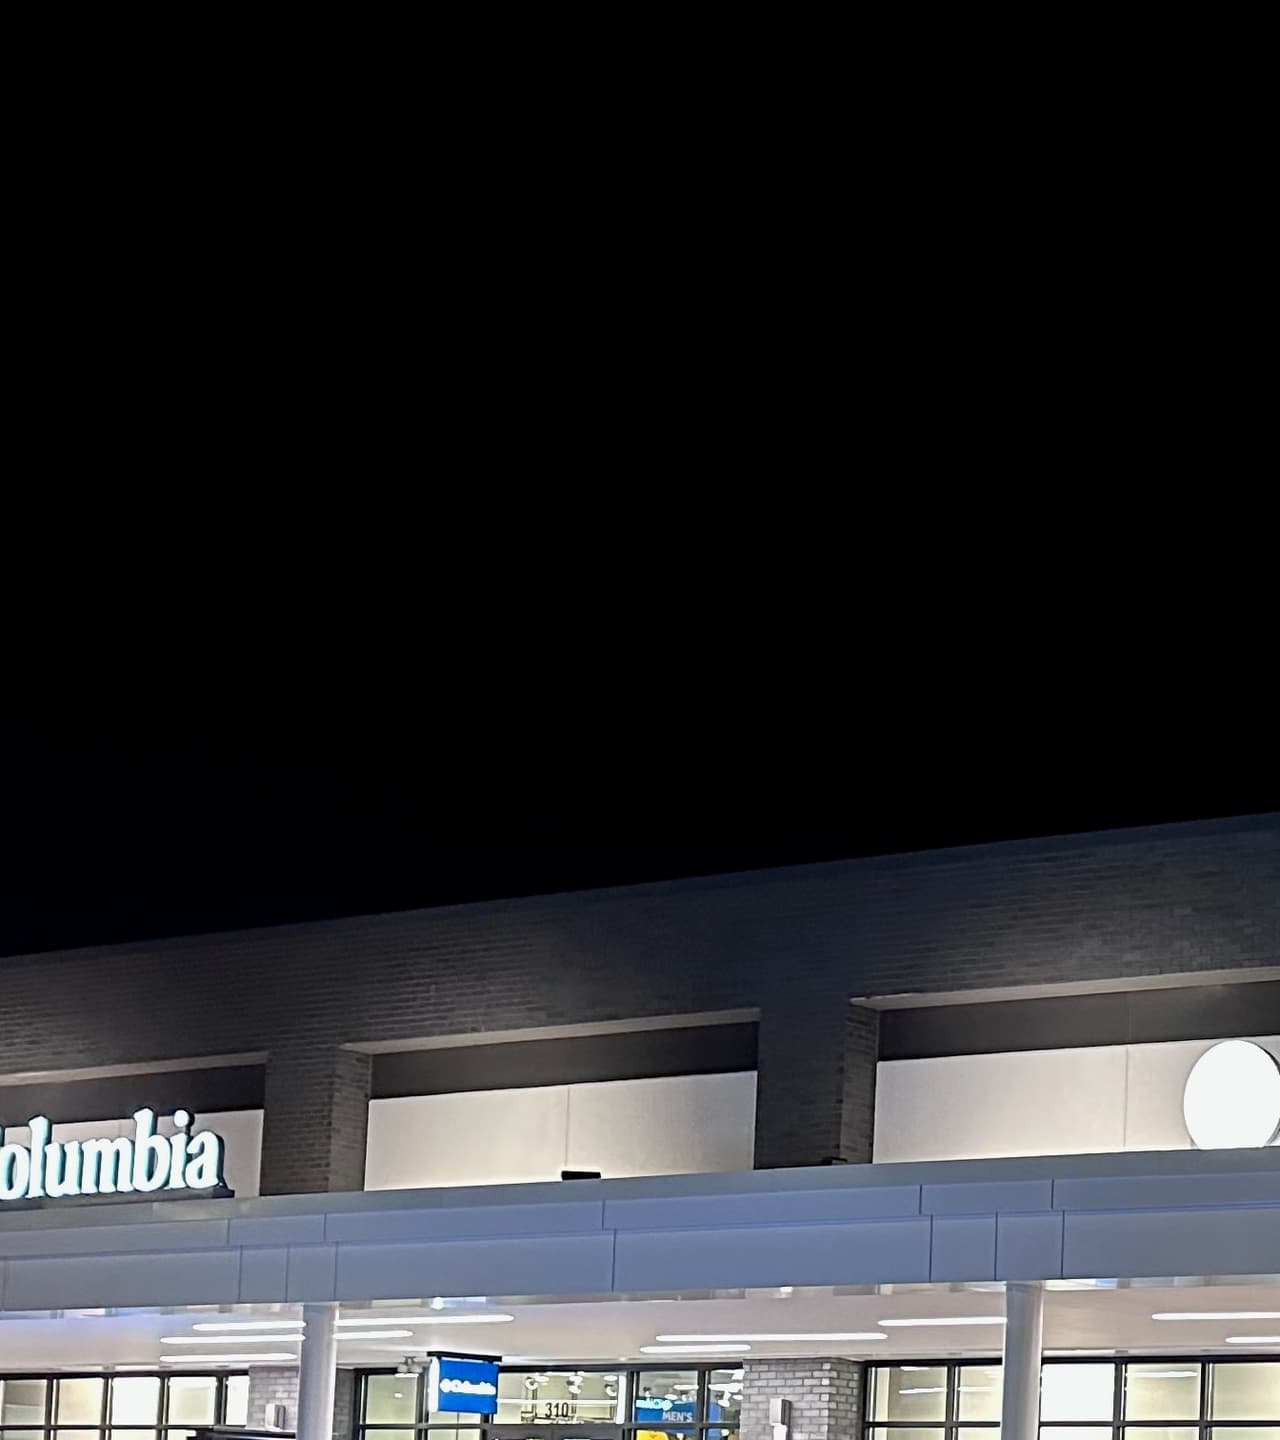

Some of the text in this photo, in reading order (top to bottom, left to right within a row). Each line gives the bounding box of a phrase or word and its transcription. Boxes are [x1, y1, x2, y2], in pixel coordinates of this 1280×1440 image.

[0, 1107, 222, 1200] olumbia
[544, 1402, 569, 1418] 310
[662, 1411, 693, 1423] MEN'S
